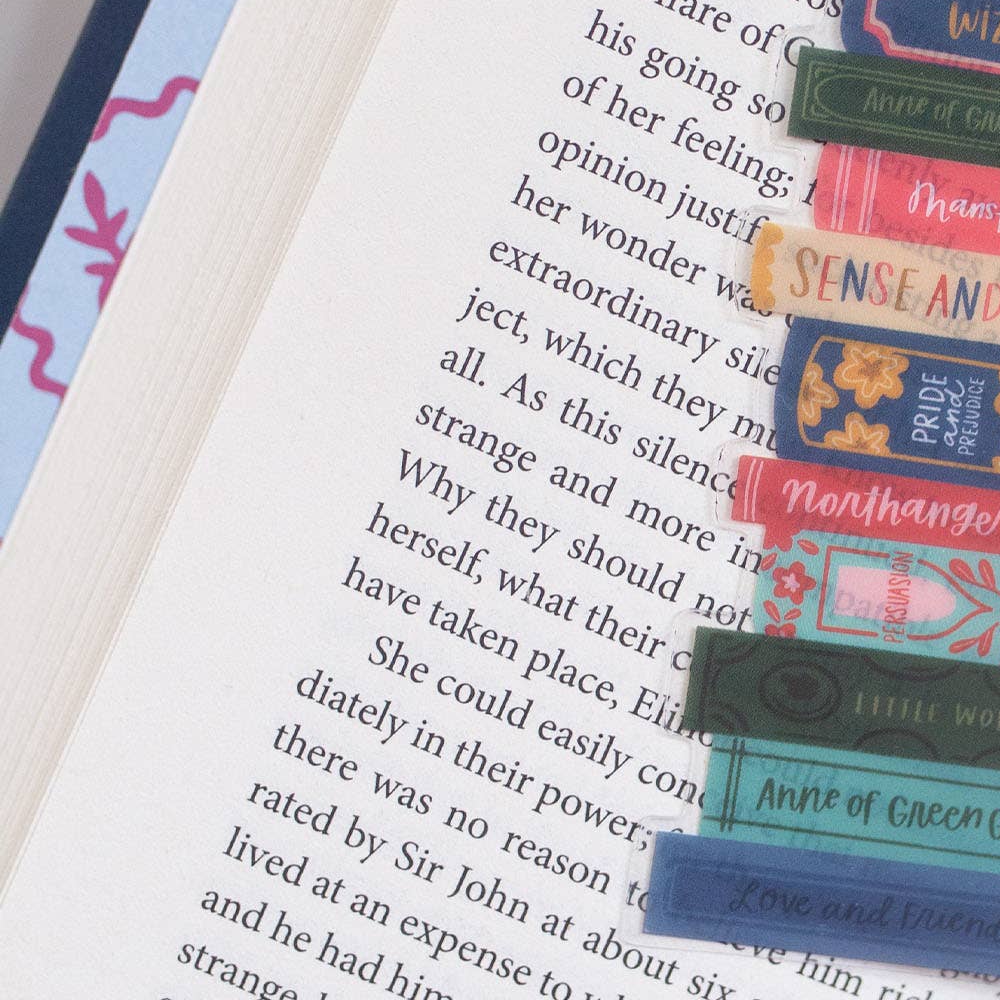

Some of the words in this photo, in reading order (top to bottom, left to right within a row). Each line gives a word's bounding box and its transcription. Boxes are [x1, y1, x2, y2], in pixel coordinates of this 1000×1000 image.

[583, 8, 637, 57] his
[639, 47, 742, 112] going
[747, 93, 786, 124] so
[741, 24, 785, 55] of
[538, 131, 667, 205] opinion
[563, 75, 608, 107] of
[605, 84, 666, 135] her
[670, 116, 794, 199] feeling;
[510, 173, 572, 225] her
[581, 212, 707, 286] wonder
[789, 247, 916, 306] SENSE
[455, 286, 529, 345] ject,
[545, 327, 642, 392] which
[652, 372, 729, 432] they
[489, 240, 721, 364] extraordinary
[439, 346, 486, 387] all.
[499, 372, 548, 412] As
[559, 397, 623, 445] this
[911, 372, 949, 446] PRIDE
[942, 379, 967, 449] and
[958, 376, 987, 457] PREJUDICE
[415, 404, 537, 474] strange
[549, 465, 618, 508] and
[624, 498, 716, 552] more
[364, 501, 490, 585] herself,
[499, 568, 580, 622] what
[584, 604, 667, 660] their
[399, 447, 477, 516] Why
[484, 494, 561, 554] they
[566, 533, 686, 603] should
[690, 592, 752, 633] not
[883, 550, 916, 643] PERSUASION
[340, 555, 421, 616] have
[428, 599, 519, 663] taken
[520, 647, 618, 710] place,
[297, 668, 409, 746] diately
[410, 718, 447, 759] in
[454, 740, 535, 795] their
[532, 781, 654, 851] power;
[367, 635, 430, 684] She
[436, 675, 535, 730] could
[537, 719, 634, 780] easily
[855, 691, 943, 724] LITTLE
[273, 723, 359, 782] there
[373, 771, 433, 815] was
[442, 806, 489, 840] no
[499, 831, 611, 895] reason
[756, 777, 839, 813] Anne
[846, 787, 877, 818] of
[887, 794, 983, 836] Green
[201, 891, 268, 933] and
[270, 911, 312, 953] he
[317, 932, 385, 985] had
[222, 825, 310, 887] lived
[311, 876, 347, 905] at
[349, 893, 391, 927] an
[399, 915, 532, 986] expense
[539, 970, 573, 1000] to
[246, 782, 339, 836] rated
[343, 814, 389, 865] by
[394, 840, 445, 884] Sir
[446, 864, 530, 924] John
[540, 913, 576, 942] at
[582, 927, 680, 986] about
[686, 974, 737, 1000] six
[821, 896, 894, 928] and
